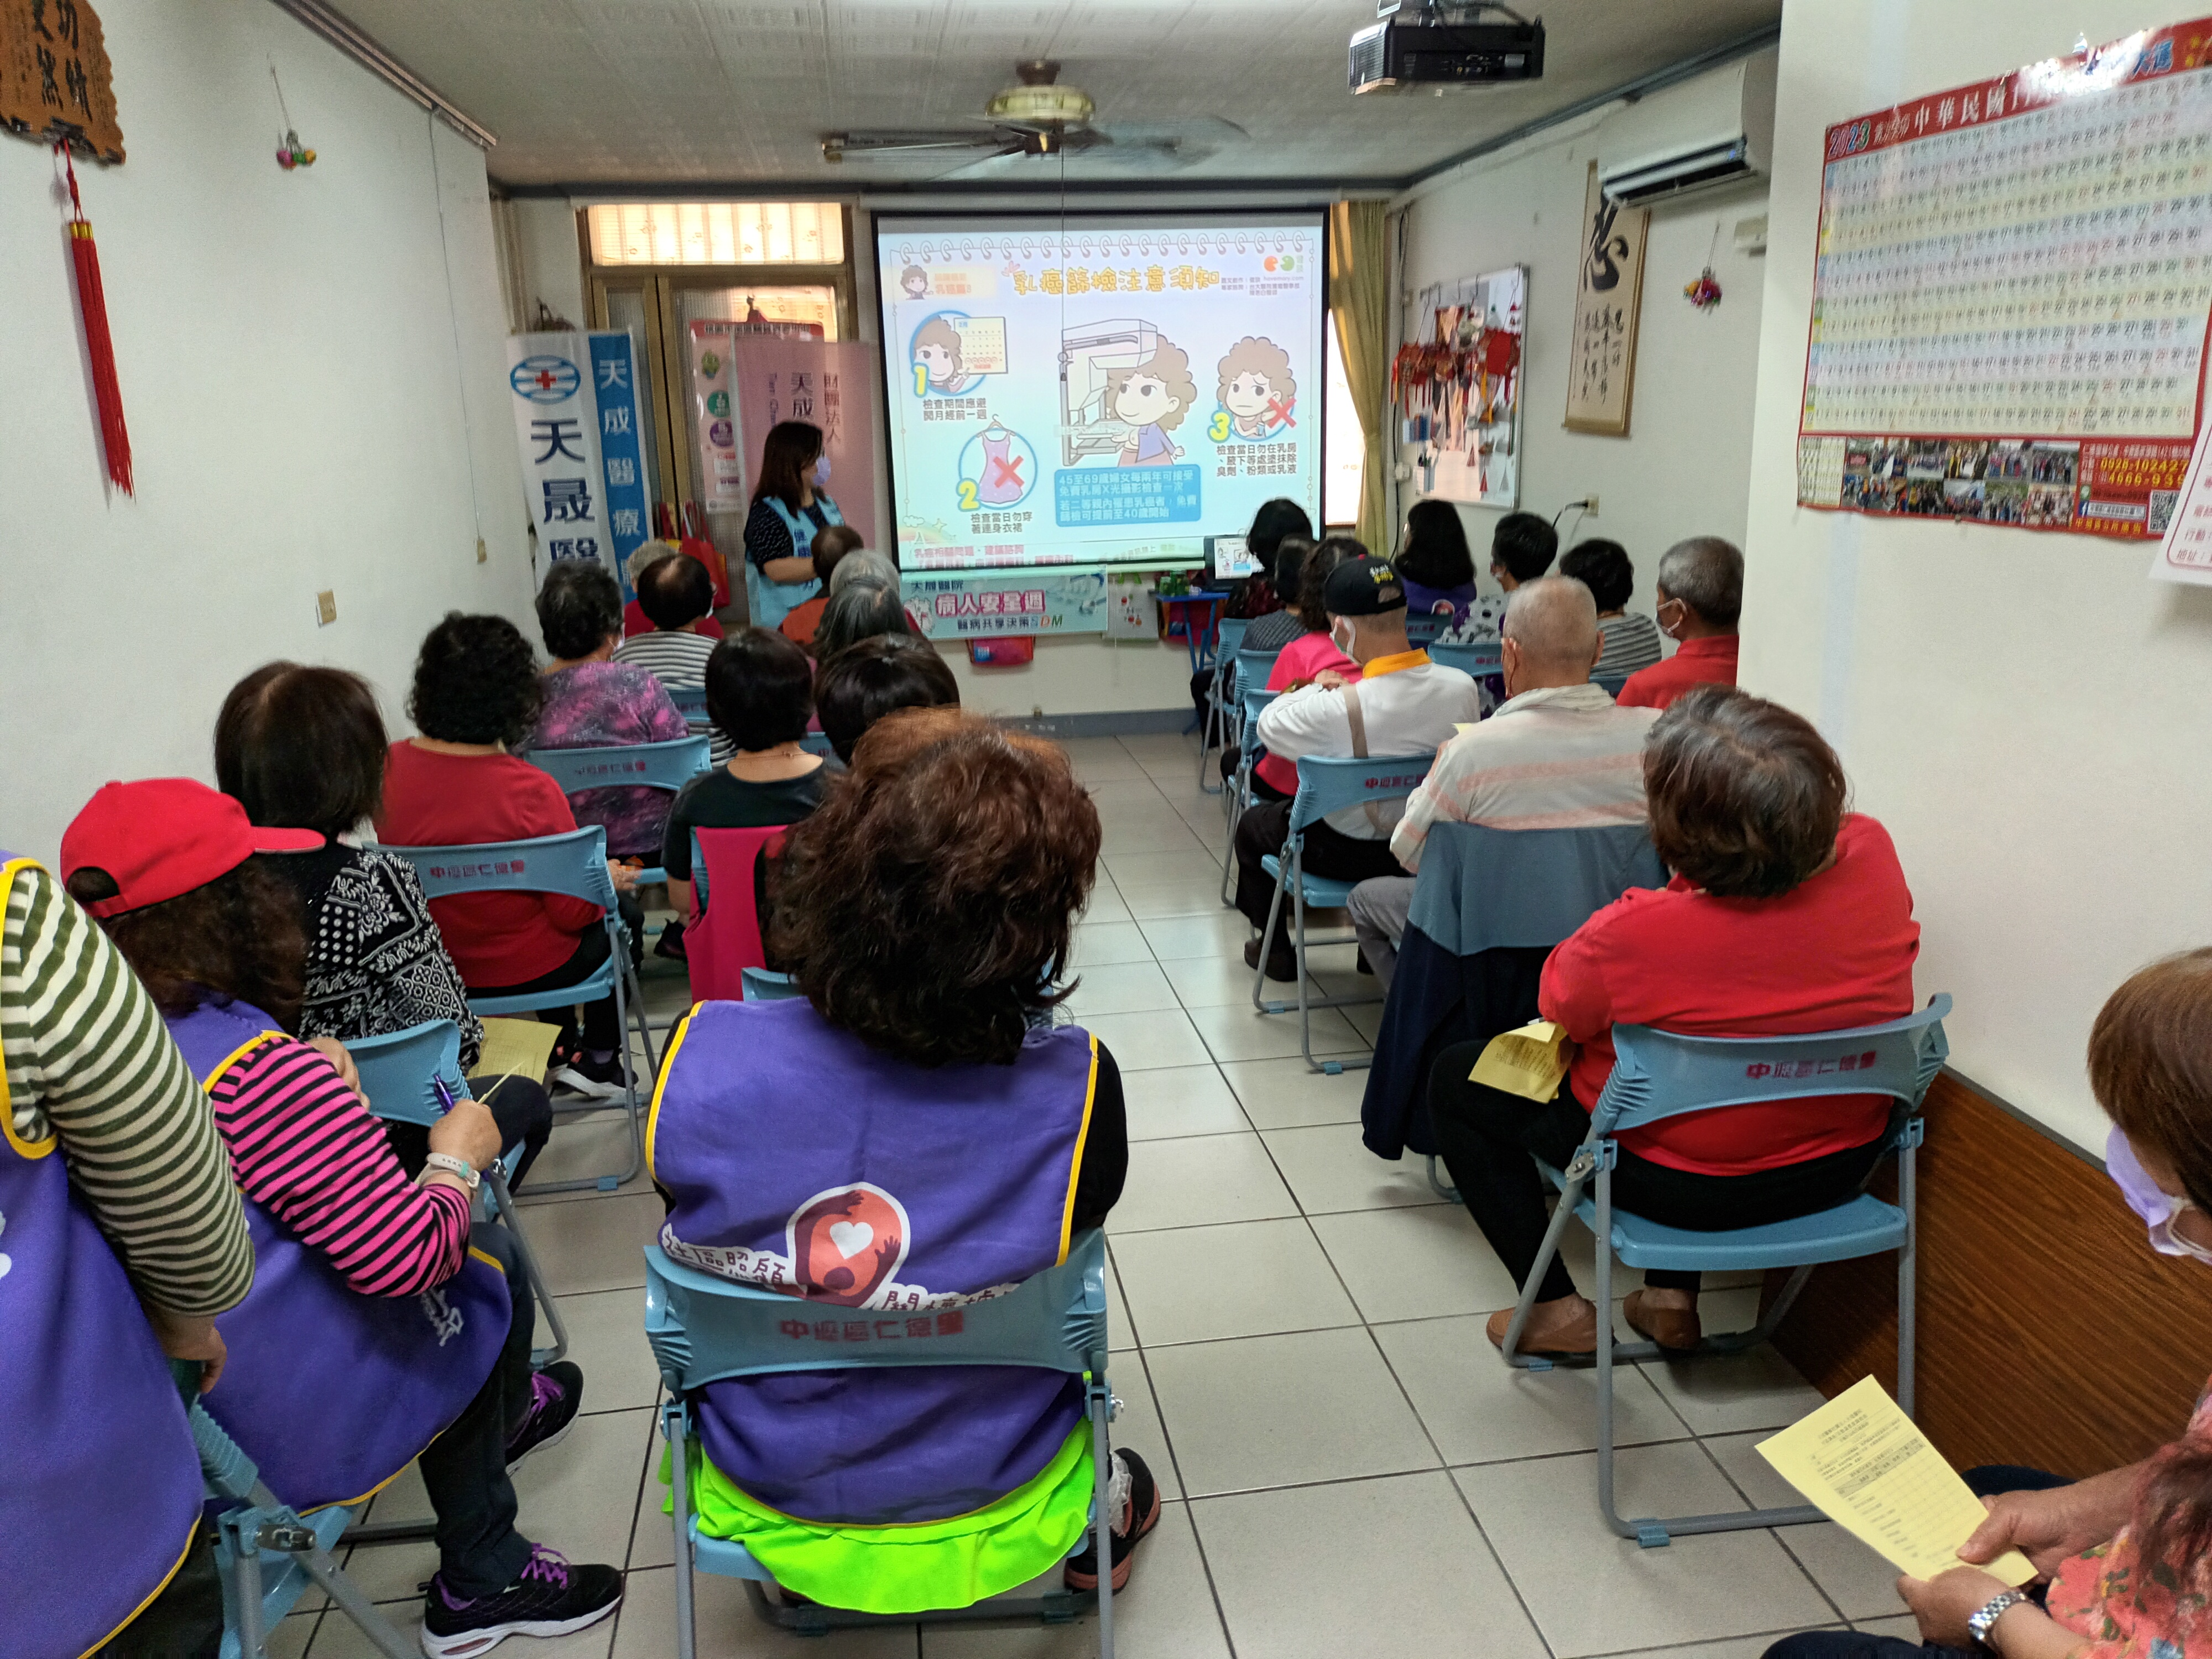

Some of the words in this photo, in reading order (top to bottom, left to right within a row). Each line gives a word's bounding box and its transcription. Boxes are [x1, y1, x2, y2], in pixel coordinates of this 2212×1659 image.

[1828, 119, 1870, 159] 2023
[1014, 264, 1219, 295] 乳癌篩檢注意須知
[923, 398, 987, 410] 檢查期間應避
[923, 409, 987, 421] 開月經前一週
[1208, 410, 1231, 442] 3
[1217, 442, 1297, 455] 檢查當日勿在乳房
[1059, 470, 1193, 485] 45至69歲婦女每兩年可接受
[957, 478, 981, 512] 2
[971, 512, 1032, 523] 檢查當日勿穿
[971, 523, 1022, 534] 著連身衣裙
[935, 589, 1045, 618] 病人安全週
